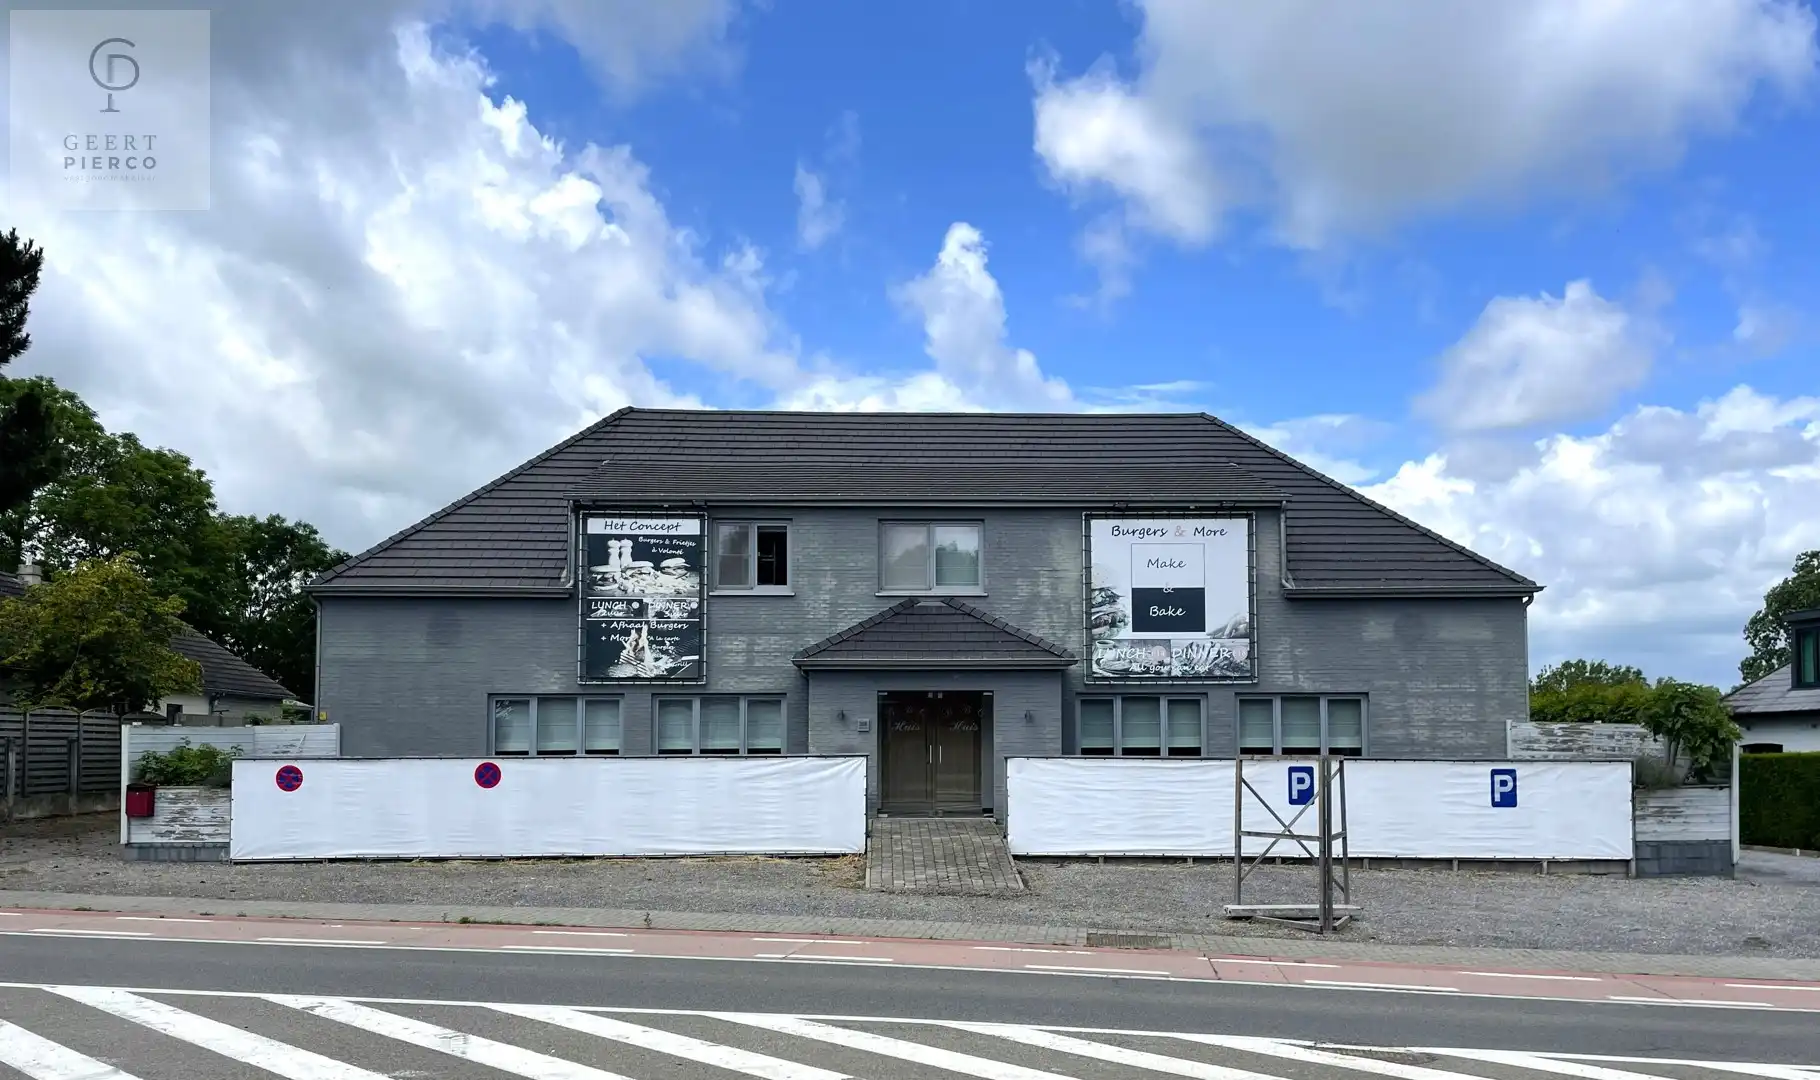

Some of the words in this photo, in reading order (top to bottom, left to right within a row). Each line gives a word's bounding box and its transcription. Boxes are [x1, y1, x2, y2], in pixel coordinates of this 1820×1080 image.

[604, 520, 626, 530] Het
[629, 521, 682, 533] Concept
[1111, 525, 1169, 539] Burgers
[1174, 525, 1187, 537] &
[1193, 526, 1228, 537] More
[638, 536, 664, 546] Burgers
[1146, 557, 1187, 569] Make
[591, 601, 627, 610] LUNCH
[1149, 605, 1187, 617] Bake
[610, 621, 645, 630] Afhaal
[650, 621, 689, 631] Burgers
[1171, 647, 1231, 660] DINNER
[1129, 662, 1147, 672] All
[1292, 772, 1310, 800] P
[1493, 774, 1513, 802] P
